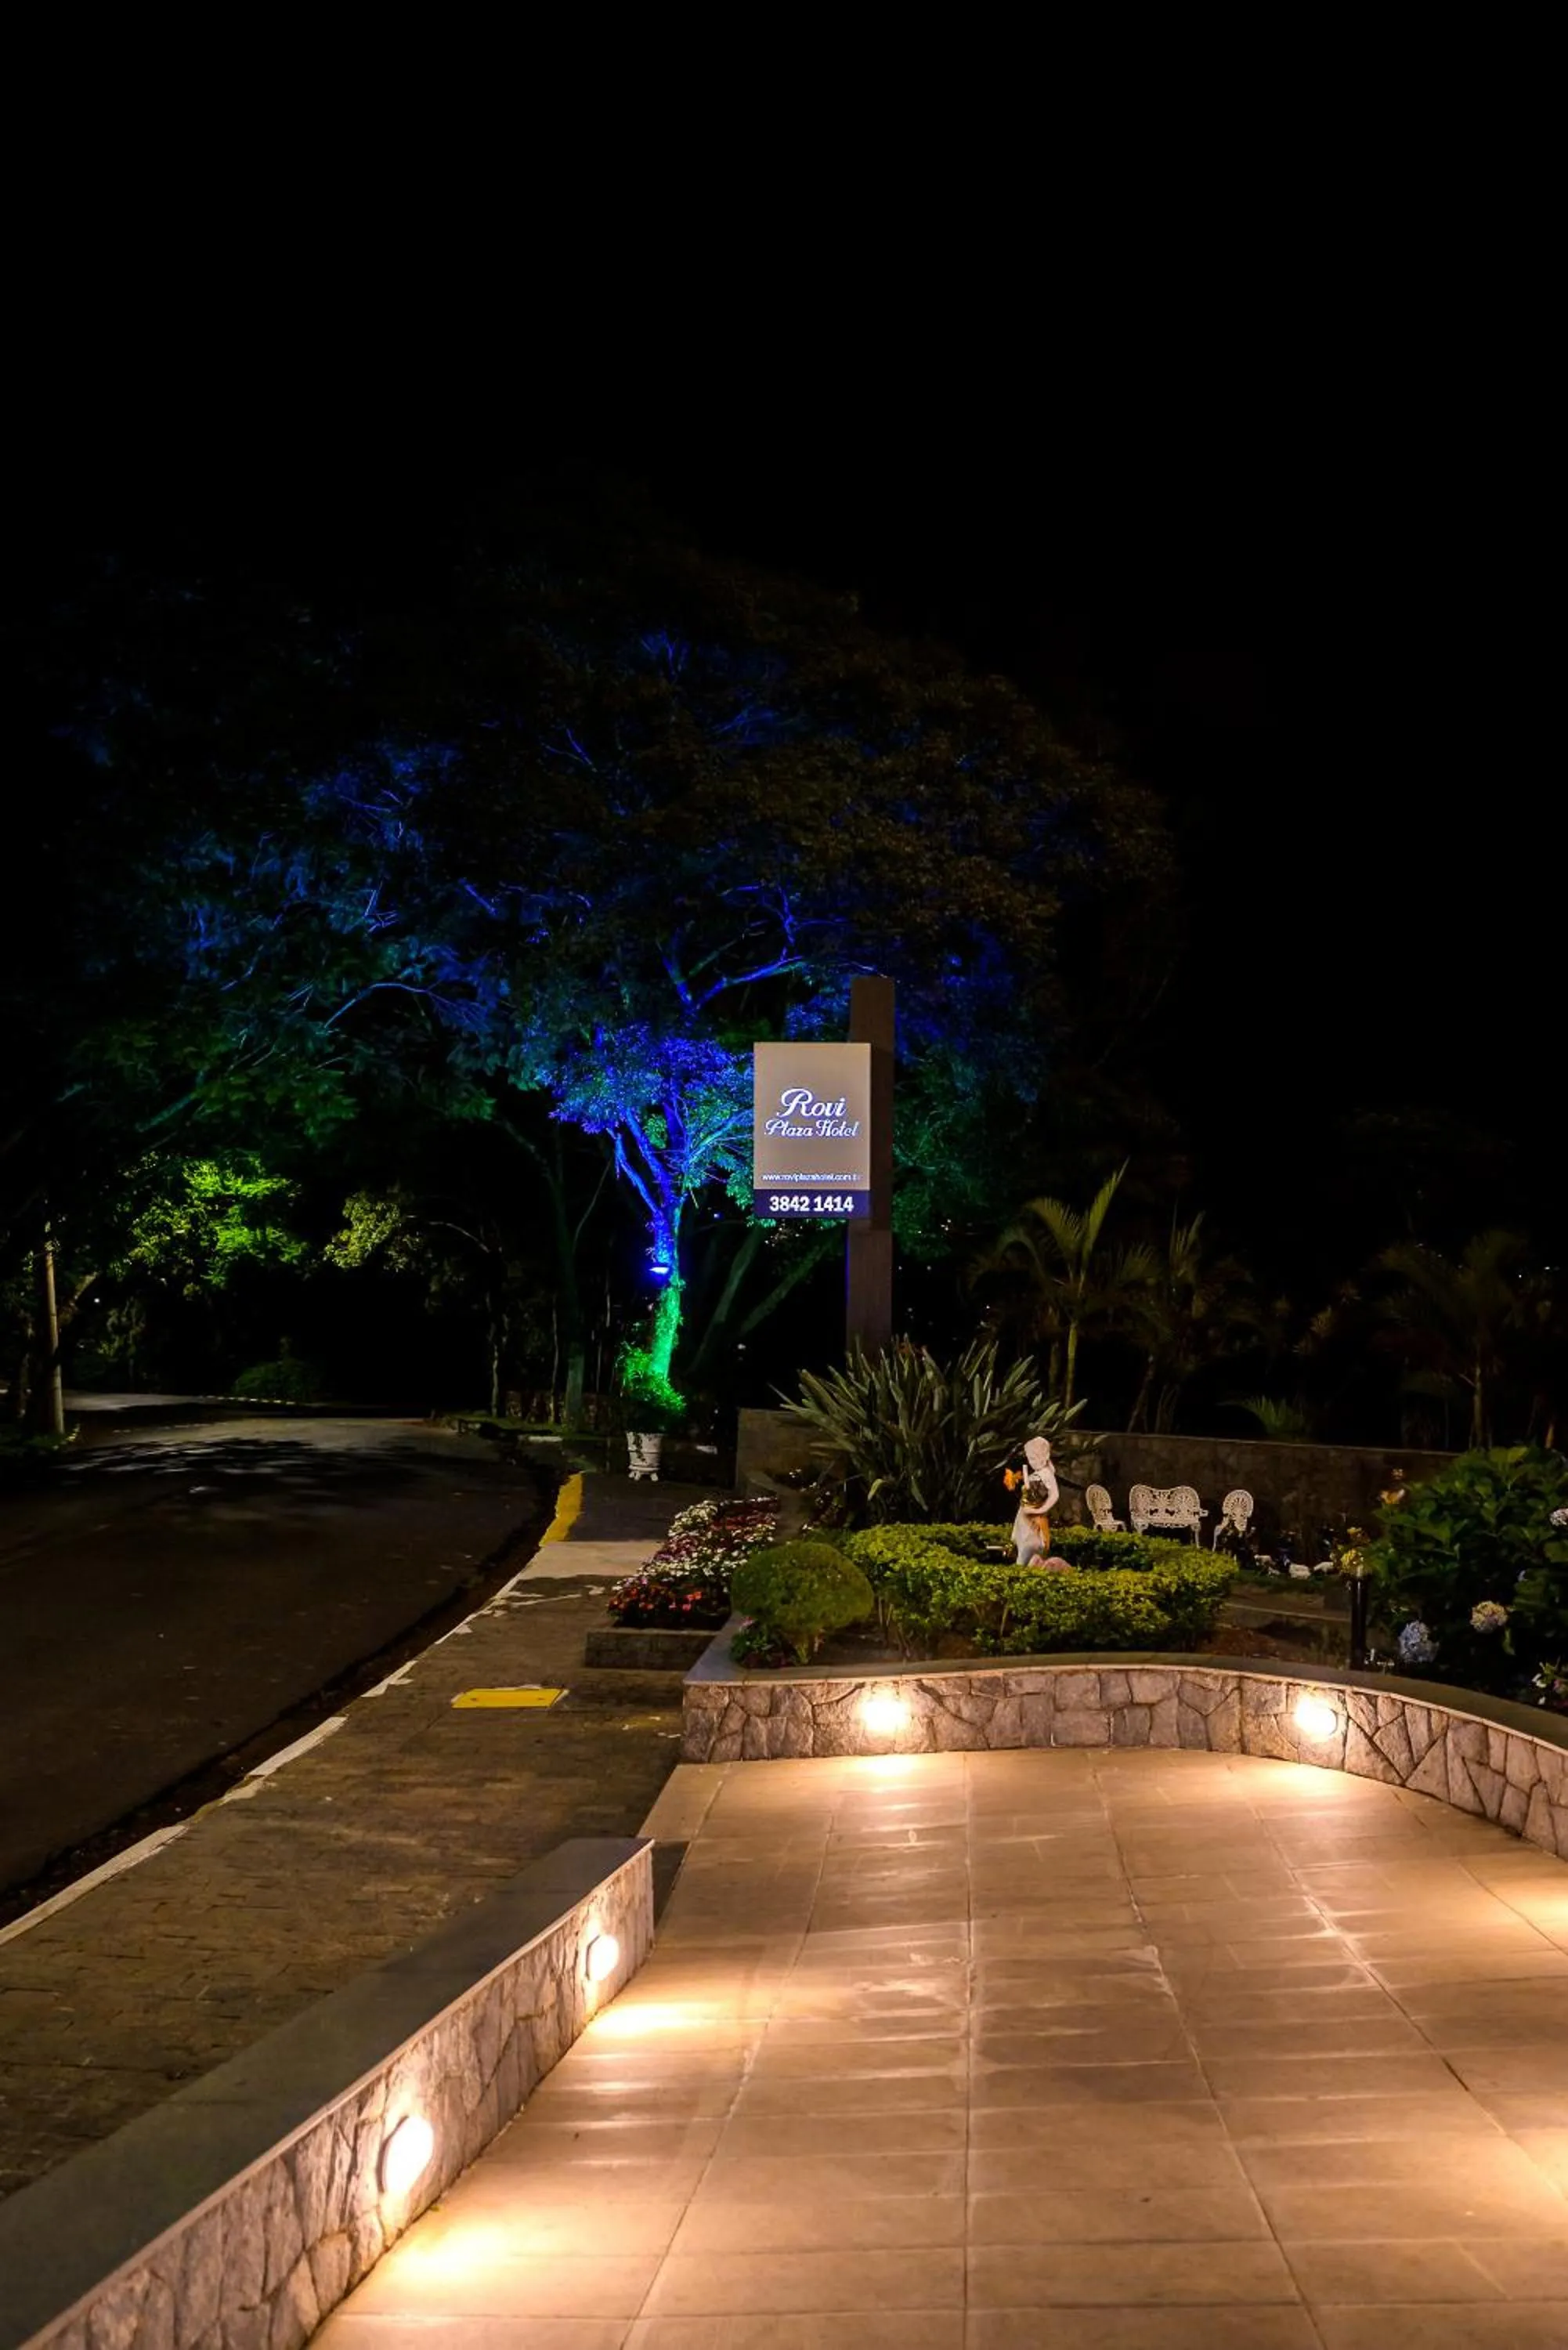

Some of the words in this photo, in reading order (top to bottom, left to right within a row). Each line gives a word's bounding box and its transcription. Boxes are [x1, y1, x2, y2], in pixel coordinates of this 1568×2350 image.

[776, 1088, 847, 1117] Rovi
[764, 1119, 814, 1137] Plaza
[815, 1119, 859, 1137] Hotel
[769, 1195, 810, 1212] 3842
[813, 1195, 854, 1212] 1414
